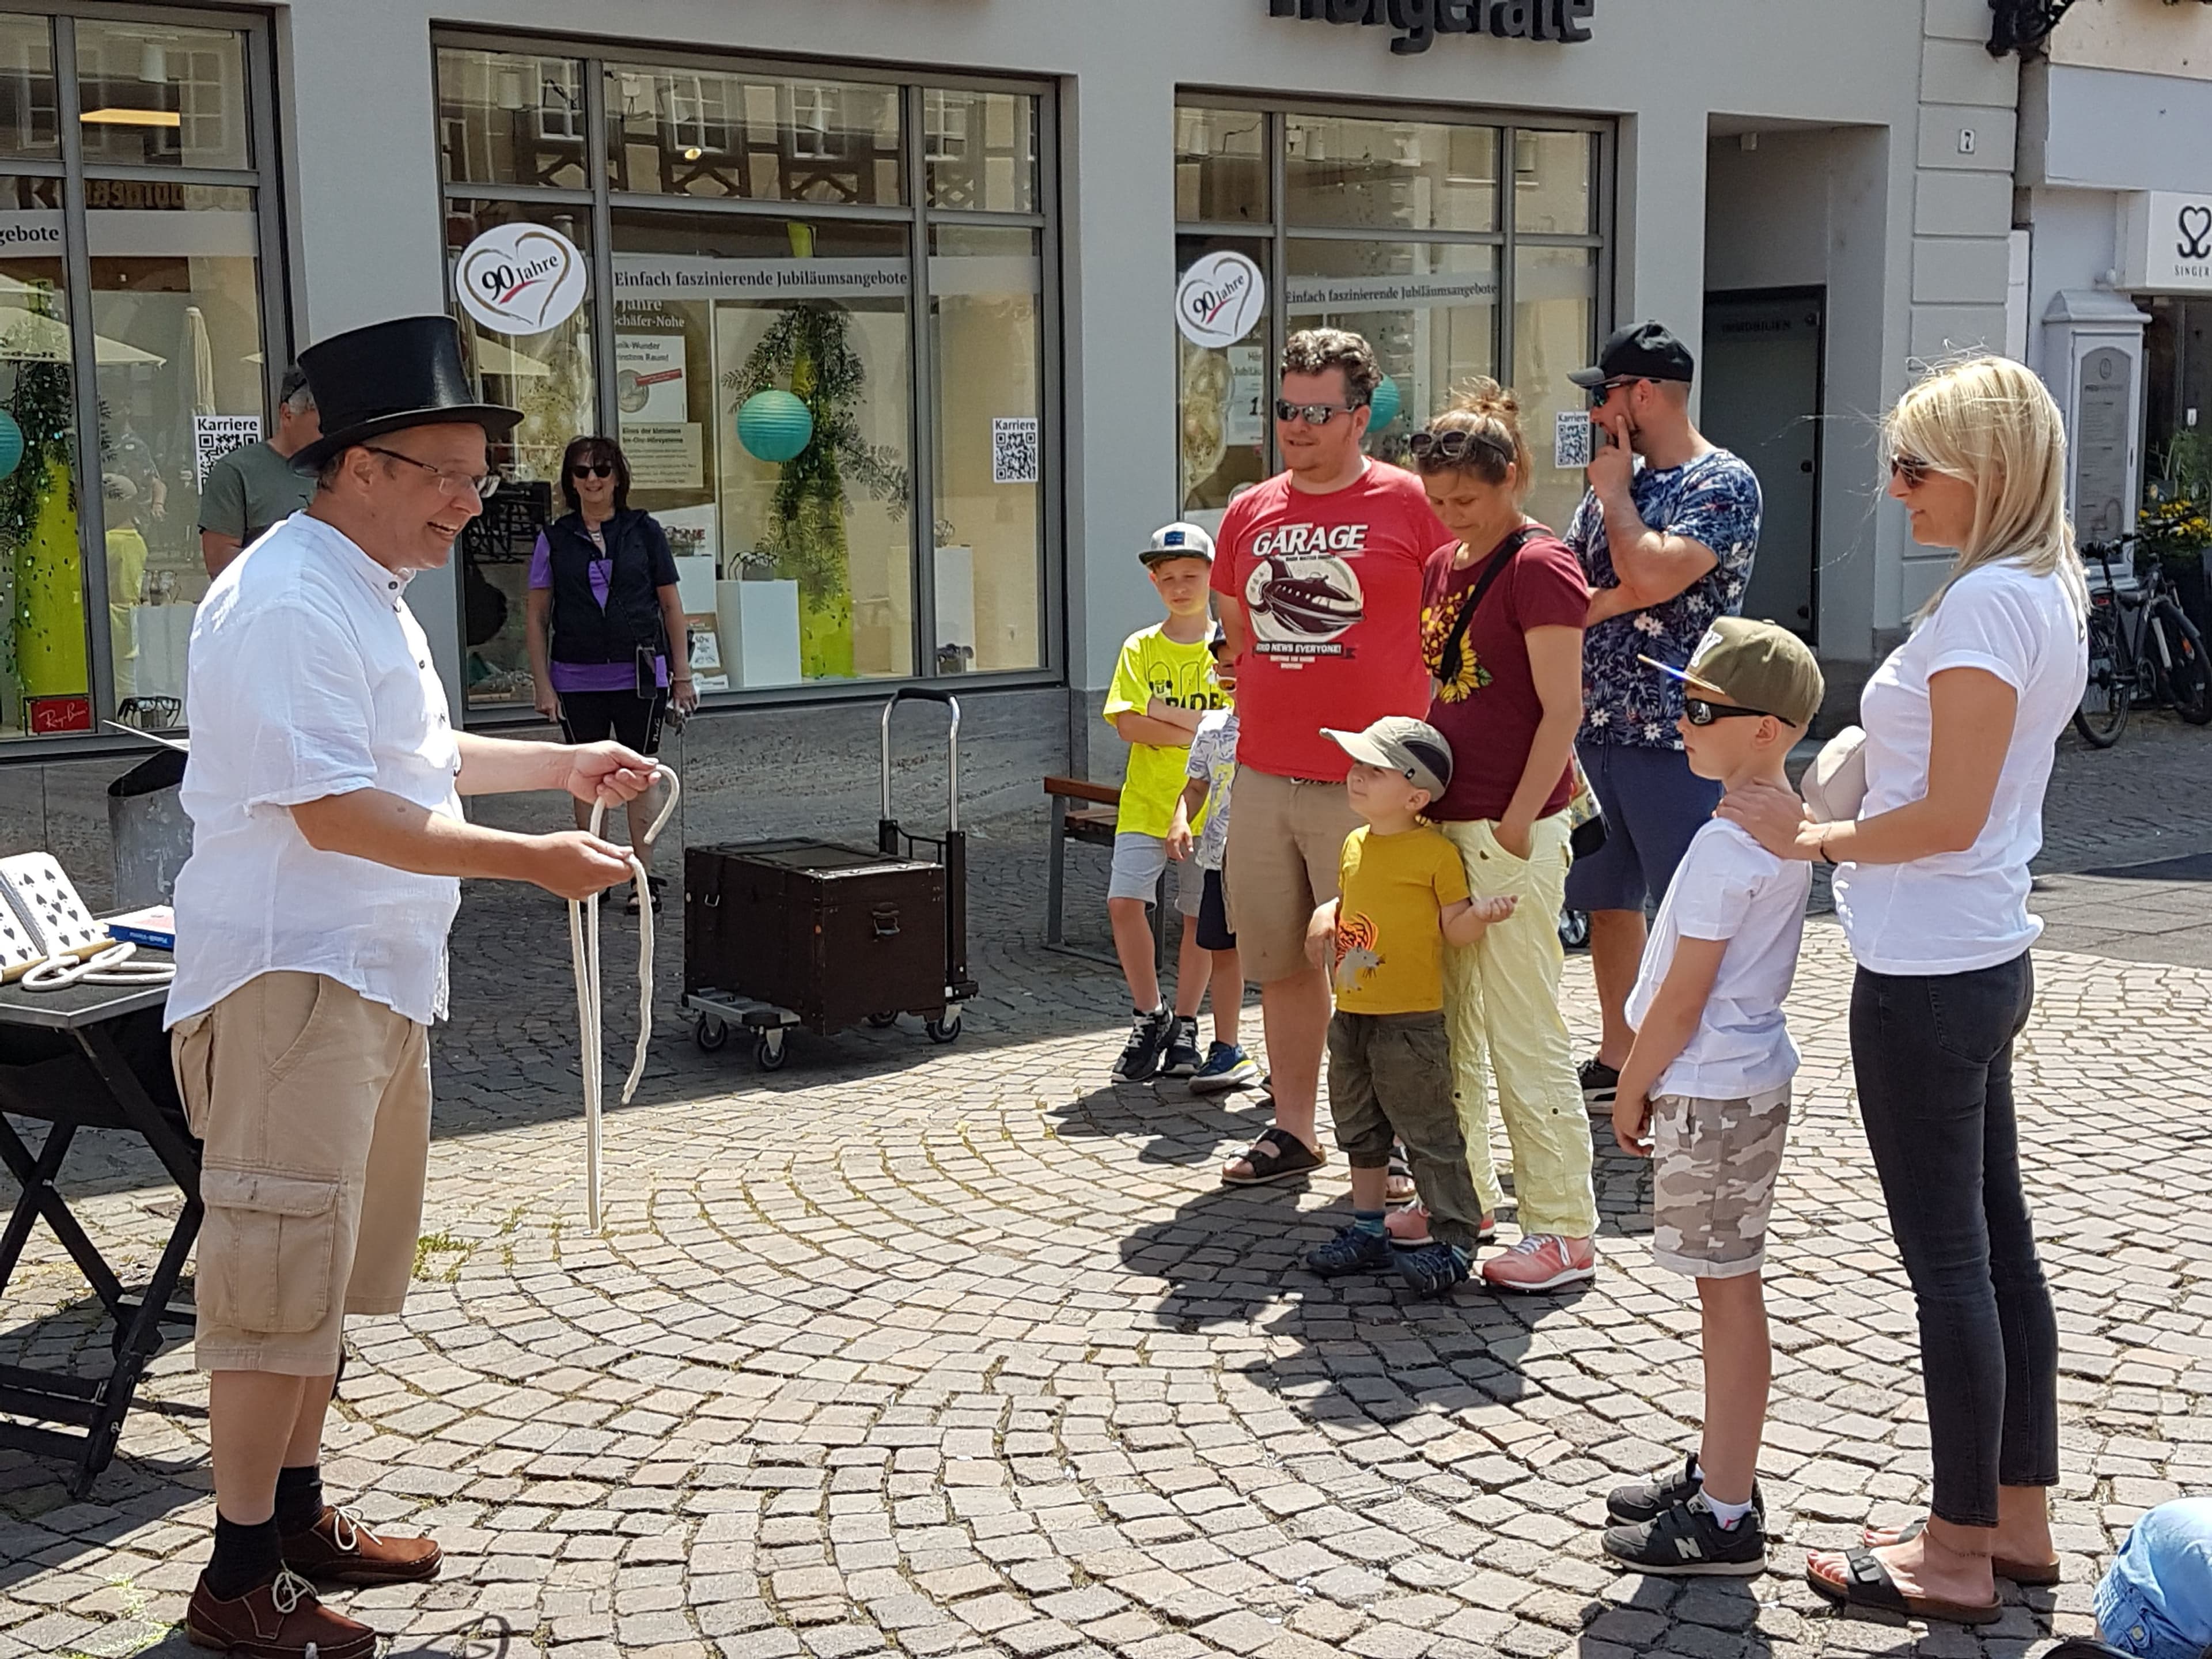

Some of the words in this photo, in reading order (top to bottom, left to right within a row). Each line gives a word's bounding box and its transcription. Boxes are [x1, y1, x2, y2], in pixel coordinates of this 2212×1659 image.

[1964, 131, 1971, 150] 7
[482, 264, 514, 301] 90
[516, 255, 559, 285] Jahre
[615, 271, 671, 287] Einfach
[676, 271, 773, 287] faszinierende
[778, 270, 908, 289] Jubiläumsangebote
[1193, 290, 1215, 323] 90
[1216, 275, 1244, 304] Jahre
[1286, 290, 1325, 304] Einfach
[1328, 287, 1398, 302] faszinierende
[1402, 282, 1498, 300] Jubiläumsangebote
[198, 418, 258, 431] Karriere
[995, 419, 1036, 431] Karriere
[1558, 412, 1589, 422] Karriere
[1252, 524, 1369, 557] GARAGE
[1674, 1536, 1703, 1559] N
